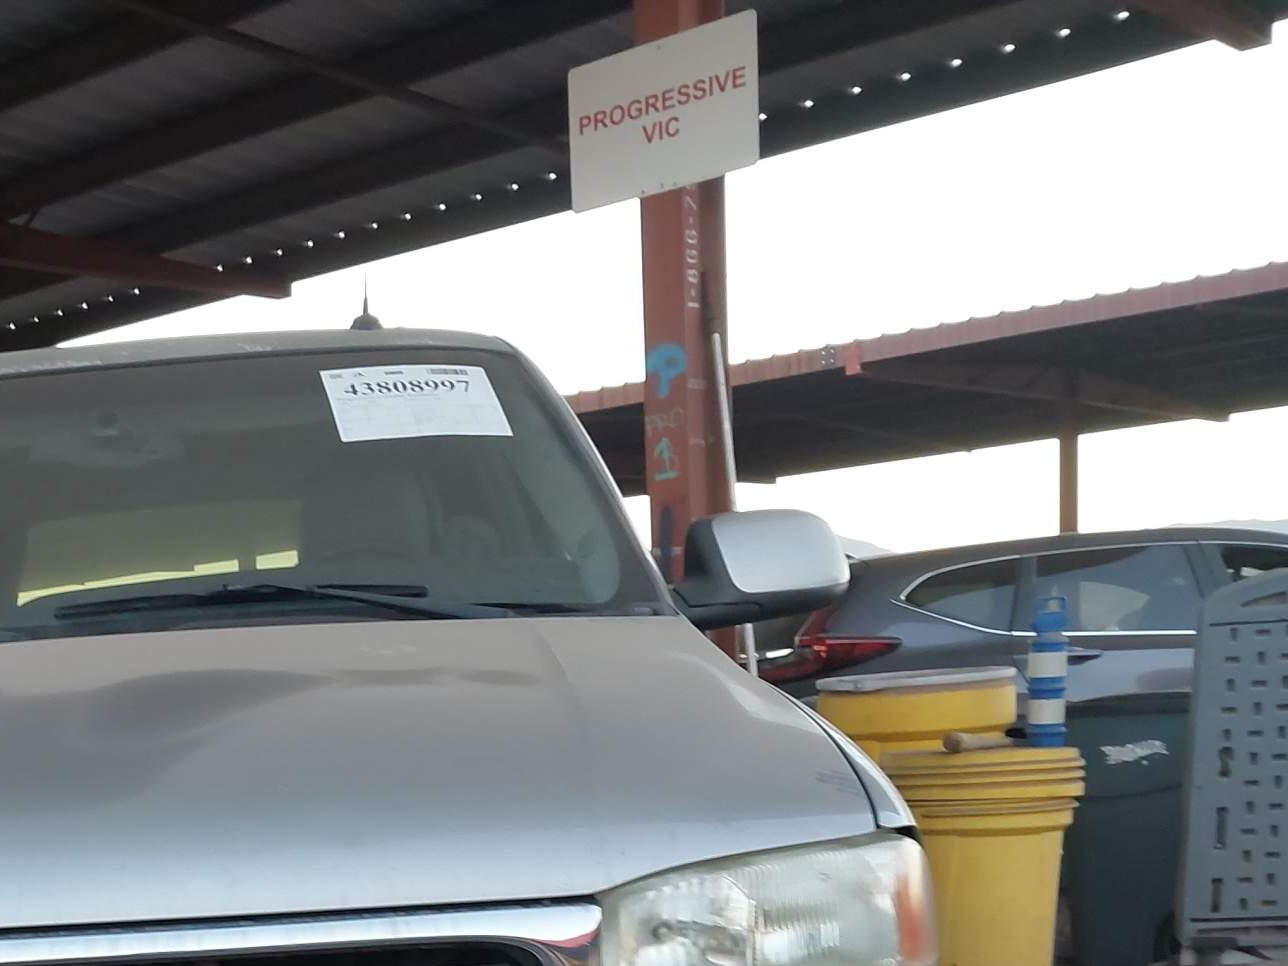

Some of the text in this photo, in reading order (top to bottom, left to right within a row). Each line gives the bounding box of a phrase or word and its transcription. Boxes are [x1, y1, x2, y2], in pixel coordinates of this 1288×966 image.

[578, 66, 747, 136] PROGRESSIVE
[642, 116, 680, 144] VIC
[684, 184, 701, 309] 1-866-7
[343, 379, 470, 396] 43808997
